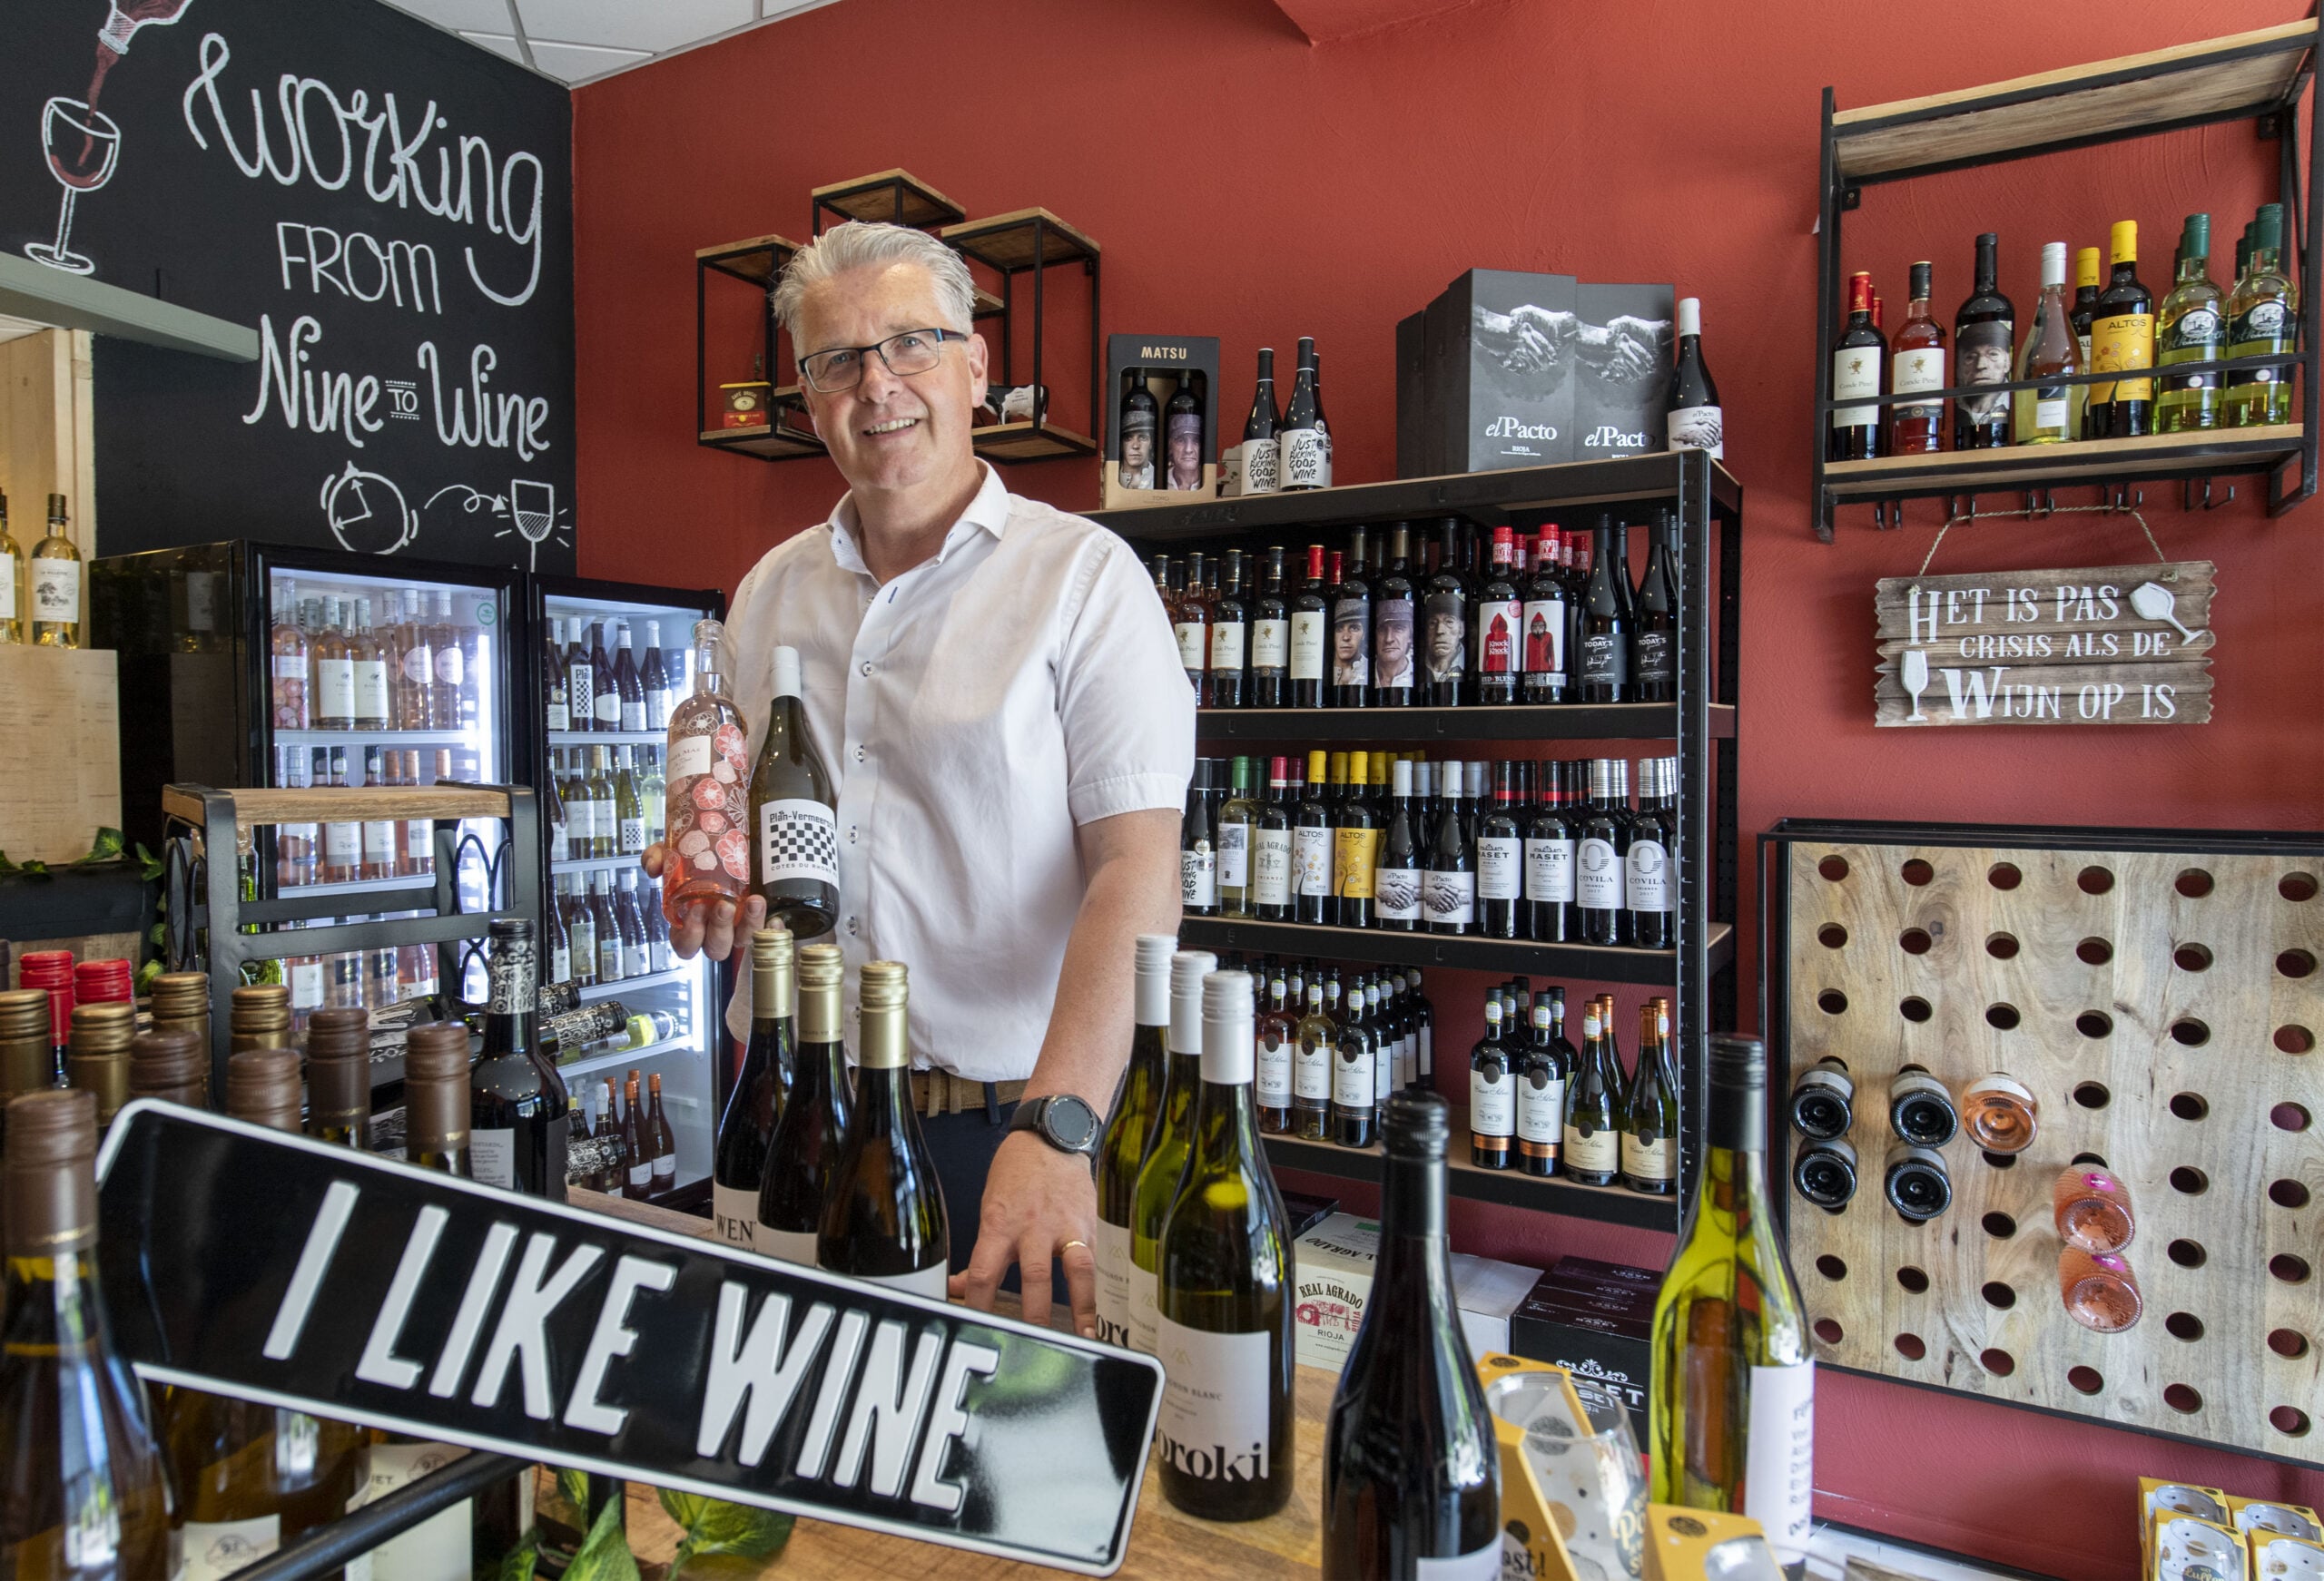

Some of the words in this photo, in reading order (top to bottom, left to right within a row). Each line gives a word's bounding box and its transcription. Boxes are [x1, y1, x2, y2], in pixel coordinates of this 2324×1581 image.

[2107, 319, 2147, 330] ALTOS
[1141, 346, 1187, 359] MATSU
[242, 313, 383, 447] Nine
[387, 386, 419, 414] TO
[417, 340, 551, 462] Wine
[1292, 438, 1316, 452] JUST
[1289, 459, 1316, 471] GOOD
[1249, 468, 1276, 481] GOOD
[1293, 469, 1316, 481] WINE
[1253, 478, 1276, 489] WINE
[1908, 588, 1991, 646] HET
[2005, 588, 2039, 623] IS
[2055, 584, 2120, 624] PAS
[1638, 637, 1667, 646] TODAY'S
[1959, 634, 2052, 659] CRISIS
[2064, 632, 2119, 658] ALS
[2133, 631, 2171, 658] DE
[1939, 666, 2061, 720] WIJN
[2078, 683, 2125, 720] OP
[2140, 683, 2176, 719] IS
[1267, 840, 1291, 854] AGRADO
[1182, 859, 1196, 871] UST
[1182, 880, 1196, 889] OD
[716, 1212, 757, 1242] WEN
[1299, 1282, 1324, 1298] REAL
[1326, 1283, 1364, 1310] AGRADO
[1351, 1310, 1362, 1333] RIOJA
[1318, 1329, 1344, 1341] RIOJA
[262, 1180, 361, 1360] I
[355, 1205, 678, 1436] LIKE
[696, 1280, 1000, 1513] WINE
[1191, 1388, 1223, 1401] BLANC
